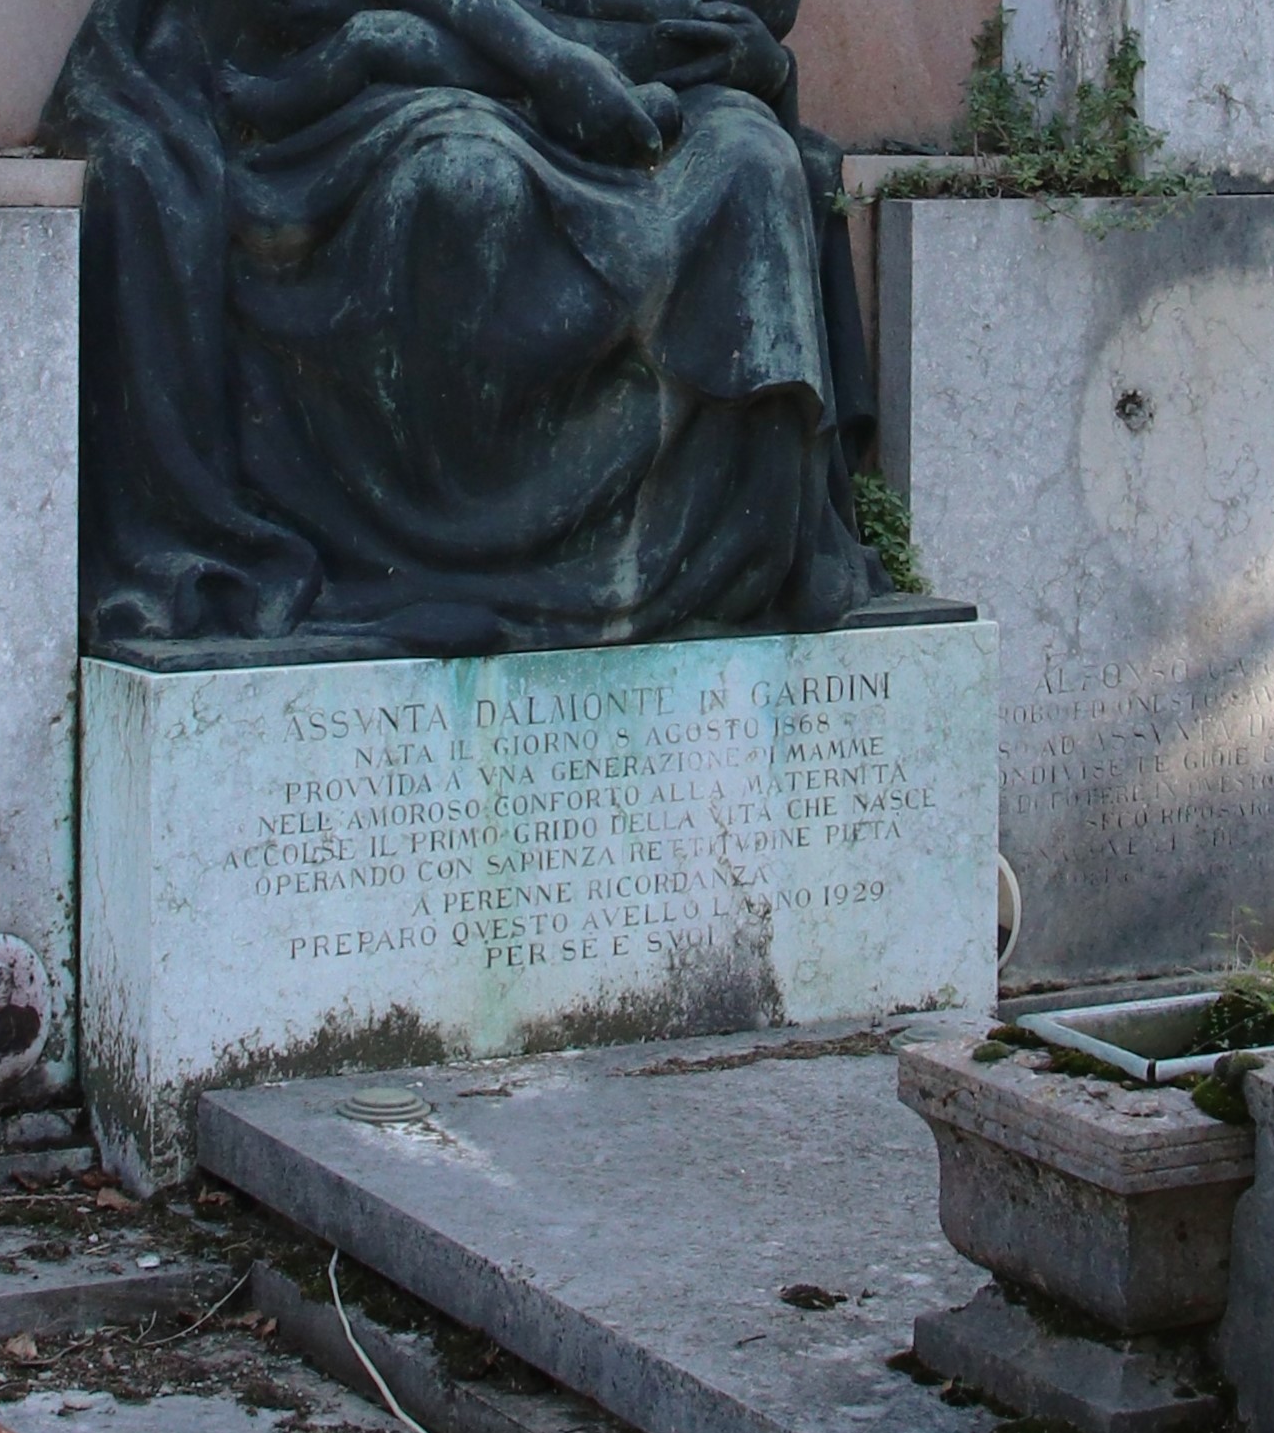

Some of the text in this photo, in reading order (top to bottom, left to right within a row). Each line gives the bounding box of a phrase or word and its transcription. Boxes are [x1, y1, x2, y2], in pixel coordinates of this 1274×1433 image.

[283, 702, 449, 743] ASSVNTA
[476, 685, 675, 728] DALMONTE
[750, 671, 892, 708] GARDINI
[354, 712, 831, 769] NATA IL GIORNO 8 AGOSTO 1868
[284, 772, 433, 805] PROVVIDA
[478, 765, 536, 788] VNA
[551, 746, 739, 783] GENERAZIONE
[785, 735, 885, 764] MAMME
[222, 837, 356, 873] ACCOLSE
[369, 834, 398, 858] IL
[410, 825, 499, 855] PRIMO
[513, 816, 598, 846] GRIDO
[609, 809, 695, 837] DELLA
[786, 795, 838, 821] CHE
[852, 786, 937, 815] NASCE
[346, 798, 481, 831] AMOROSO
[493, 785, 640, 818] CONFORTO
[649, 779, 726, 804] ALLA
[255, 863, 406, 898] OPERANDO
[417, 856, 474, 883] CON
[486, 845, 616, 877] SAPIENZA
[411, 865, 770, 919] A PERENNE RICORDANZA
[451, 912, 569, 947] QVESTO
[581, 899, 700, 932] AVELLO
[822, 879, 886, 907] 1929
[484, 942, 547, 970] PER
[612, 934, 631, 958] E
[646, 923, 715, 954] SVOI
